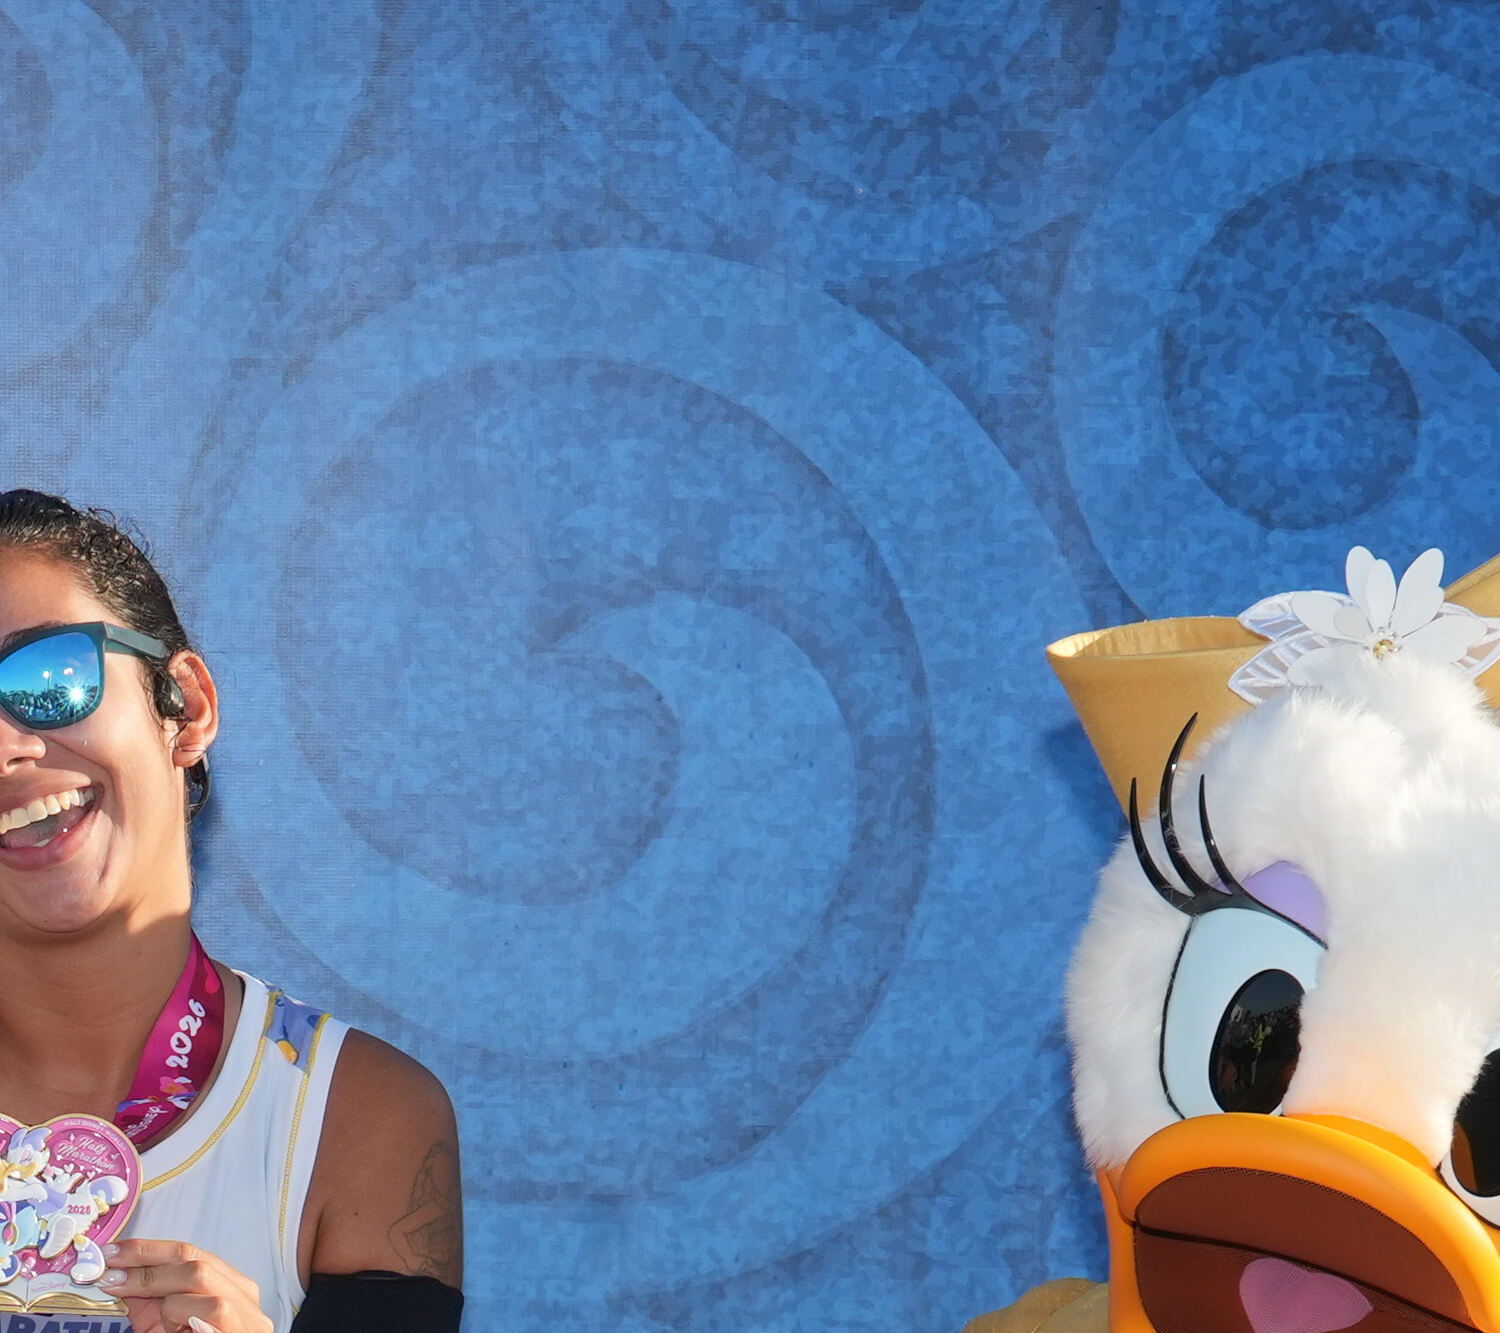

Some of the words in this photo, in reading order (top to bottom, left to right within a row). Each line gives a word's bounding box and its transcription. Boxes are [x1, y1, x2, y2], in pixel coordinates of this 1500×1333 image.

[165, 998, 206, 1069] 2026
[56, 1142, 116, 1171] Marathon
[79, 1136, 109, 1156] Half
